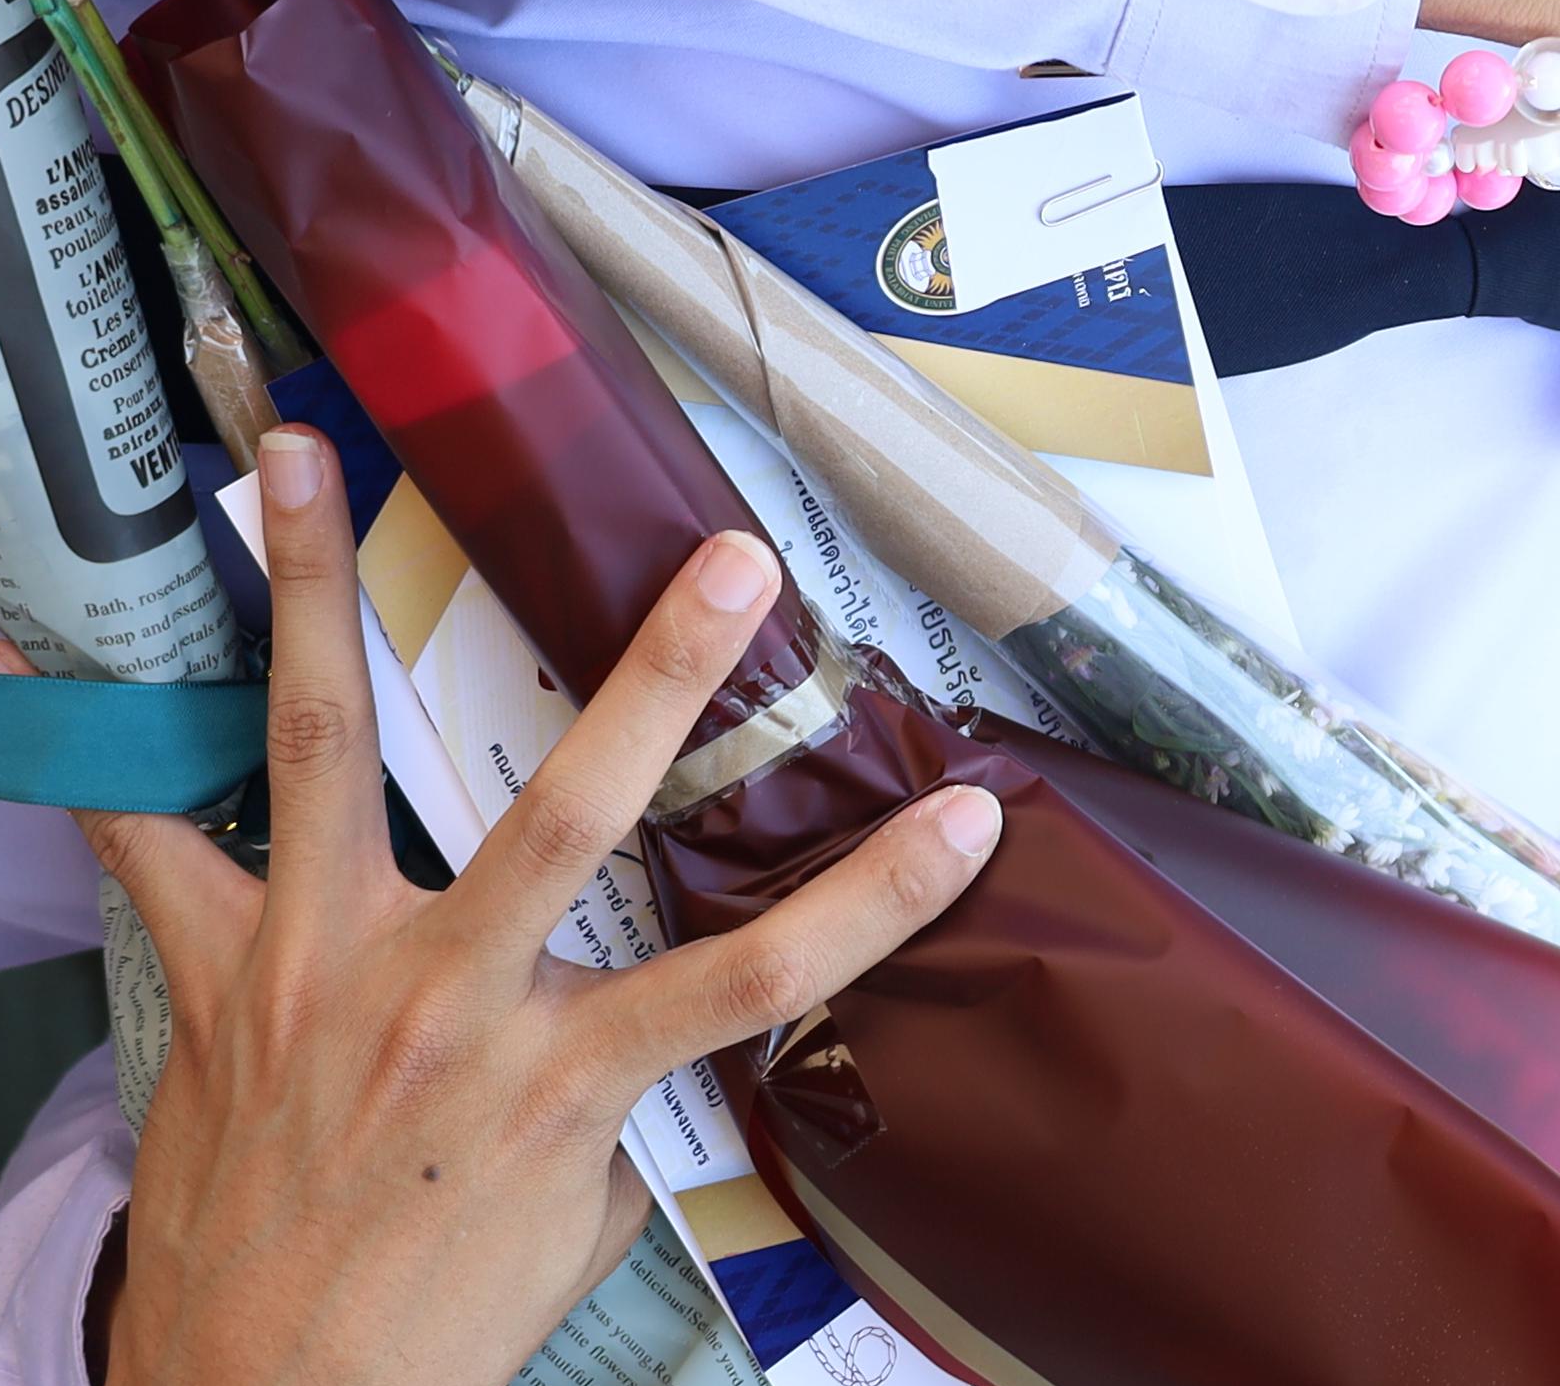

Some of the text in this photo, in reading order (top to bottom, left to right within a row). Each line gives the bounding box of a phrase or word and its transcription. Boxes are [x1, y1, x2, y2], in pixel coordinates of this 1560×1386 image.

[6, 48, 71, 128] DESINF
[92, 312, 122, 339] Les
[84, 598, 133, 618] Bath,
[94, 632, 135, 647] soap
[141, 614, 171, 638] and
